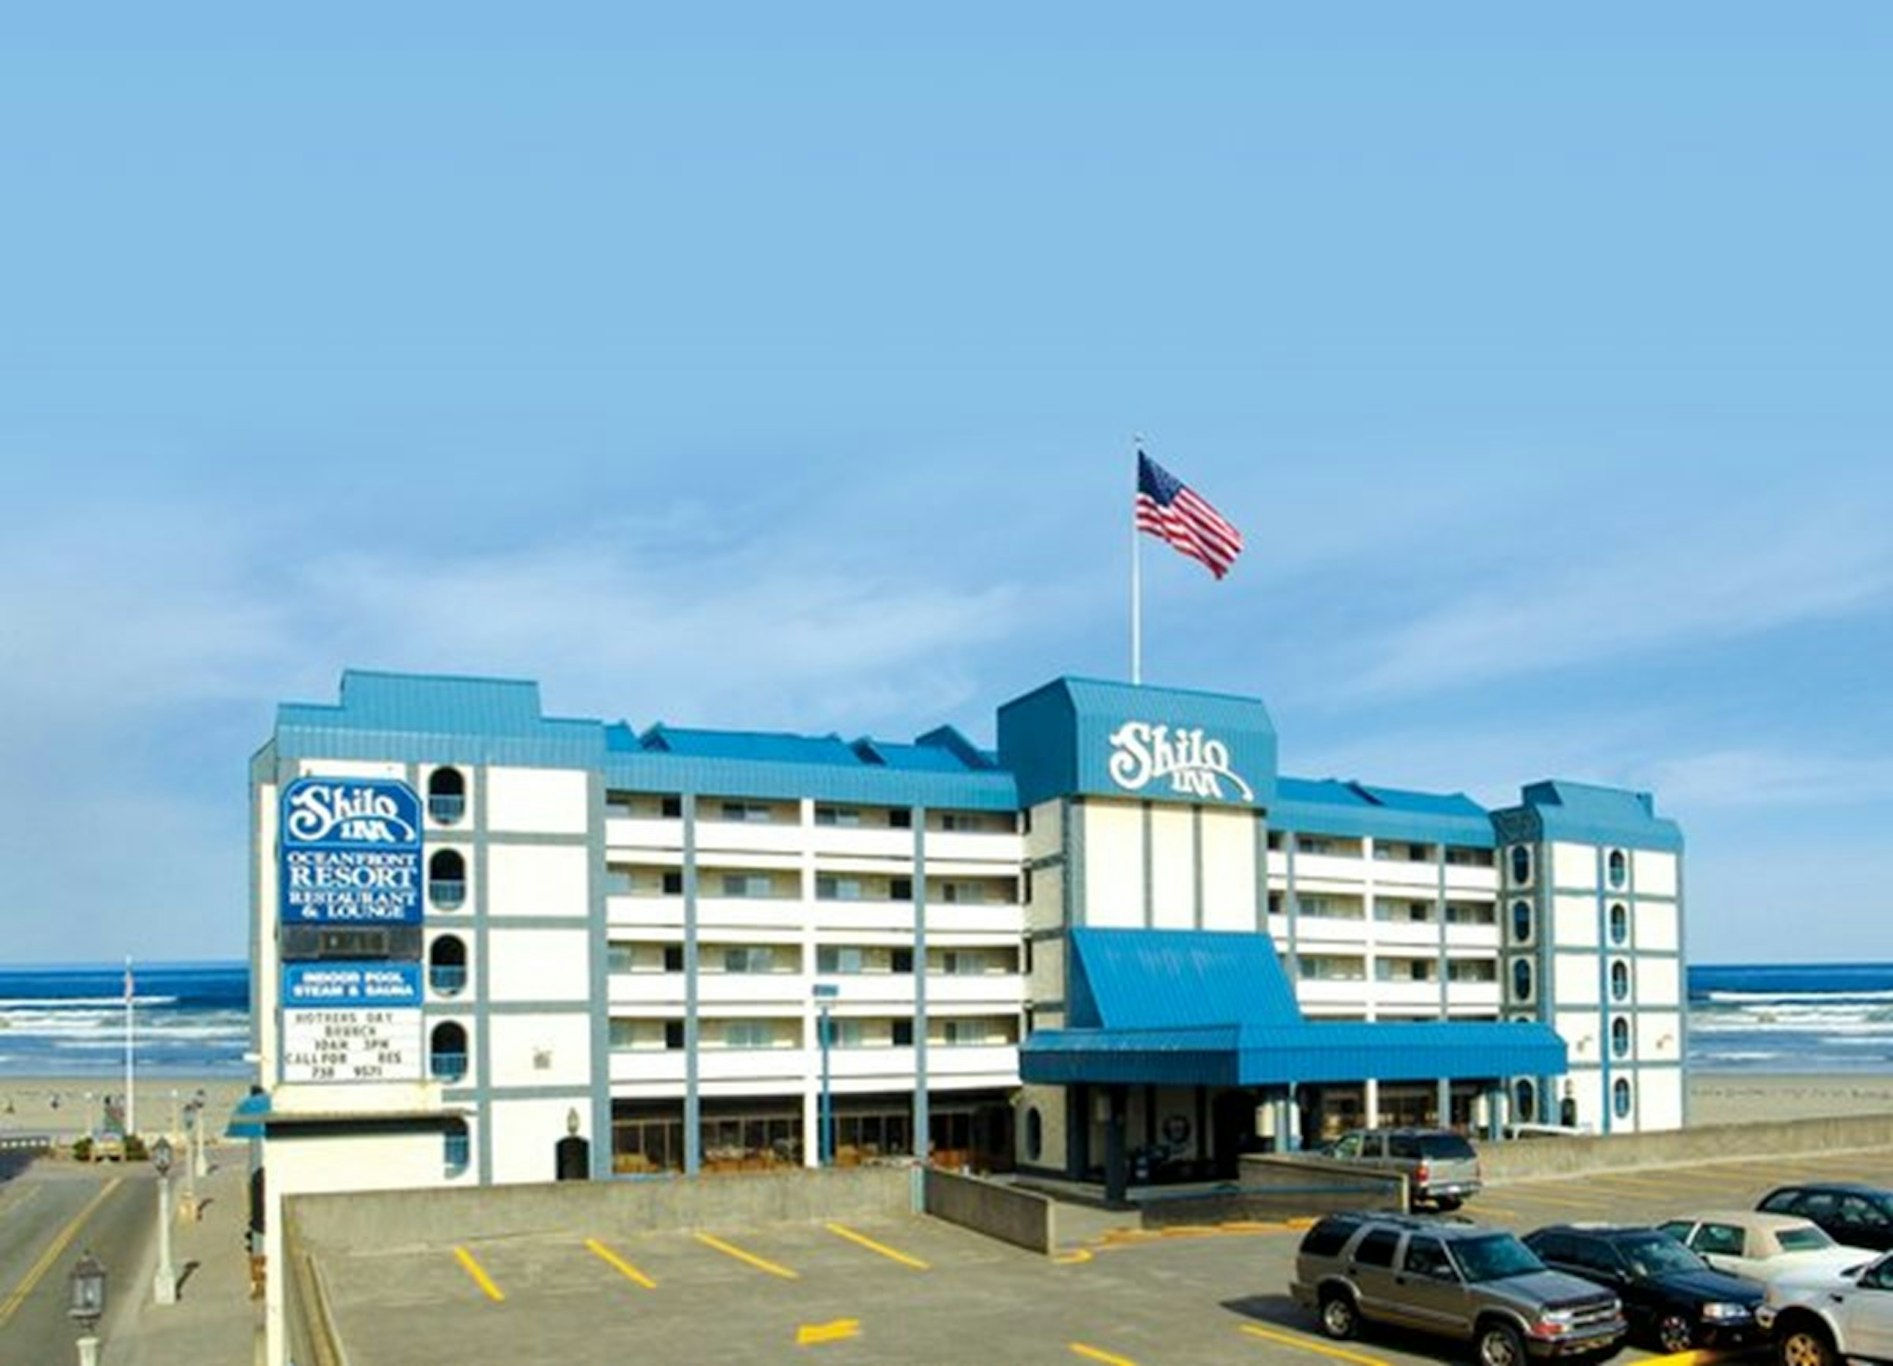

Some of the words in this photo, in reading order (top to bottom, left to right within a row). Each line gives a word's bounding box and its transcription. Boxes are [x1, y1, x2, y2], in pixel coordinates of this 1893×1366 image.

[1109, 721, 1253, 801] Shilo
[289, 785, 416, 841] Shilo
[287, 852, 417, 866] OCEANFRONT
[290, 865, 418, 888] RESORT
[289, 890, 417, 906] RESTAURANT
[302, 904, 319, 919] &
[327, 903, 405, 919] LOUNGE
[302, 971, 360, 983] INDOOR
[364, 971, 404, 983] POOL
[293, 985, 343, 997] STEAM
[364, 985, 414, 997] SAUNA
